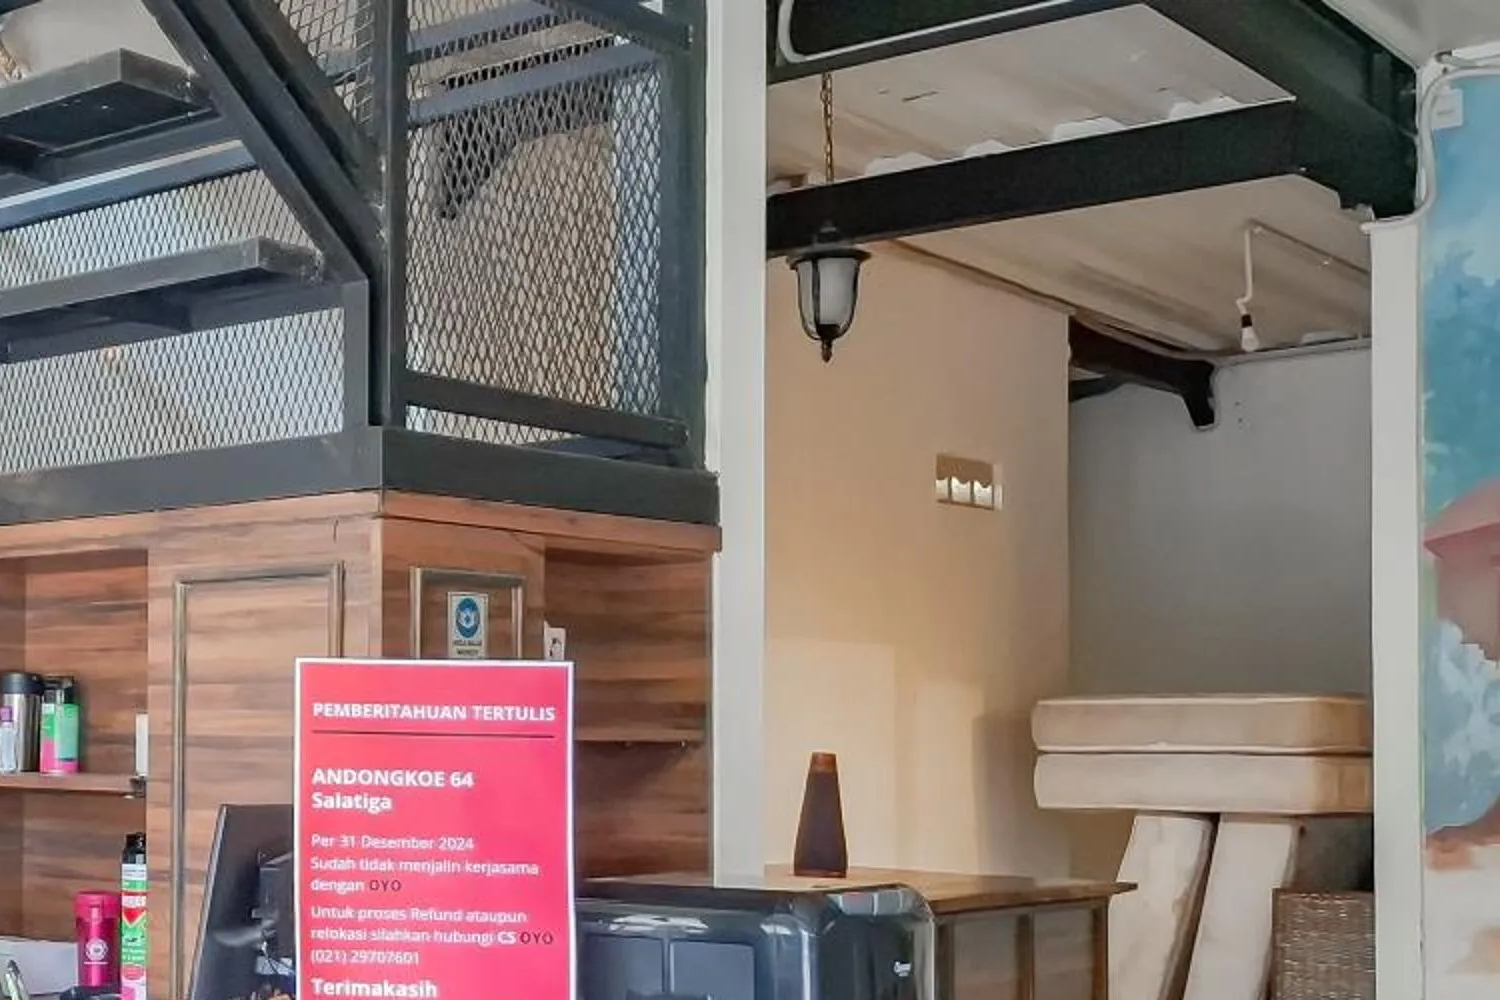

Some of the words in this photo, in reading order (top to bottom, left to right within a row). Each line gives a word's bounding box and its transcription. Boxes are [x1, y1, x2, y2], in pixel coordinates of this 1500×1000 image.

[312, 702, 467, 720] PEMBERITAHUAN
[472, 705, 556, 721] TERTULIS
[311, 768, 445, 788] ANDONGKOE
[450, 771, 475, 788] 64
[311, 791, 392, 815] Salatiga
[311, 833, 335, 848] Per
[340, 835, 355, 848] 31
[361, 835, 435, 849] Desember
[438, 837, 474, 850] 2024
[311, 857, 355, 870] Sudah
[359, 859, 394, 871] tidak
[400, 859, 461, 876] menjalin
[465, 861, 539, 876] kerjasama
[311, 878, 364, 895] dengan
[369, 879, 402, 892] OYO
[311, 905, 353, 919] Untuk
[357, 908, 406, 921] proses
[411, 908, 463, 921] Refund
[466, 911, 528, 925] ataupun
[311, 927, 367, 940] relokasi
[433, 930, 493, 947] hubungi
[498, 931, 517, 944] CS
[520, 932, 554, 945] OYO
[311, 949, 347, 965] (021)
[311, 978, 438, 998] Terimakasih
